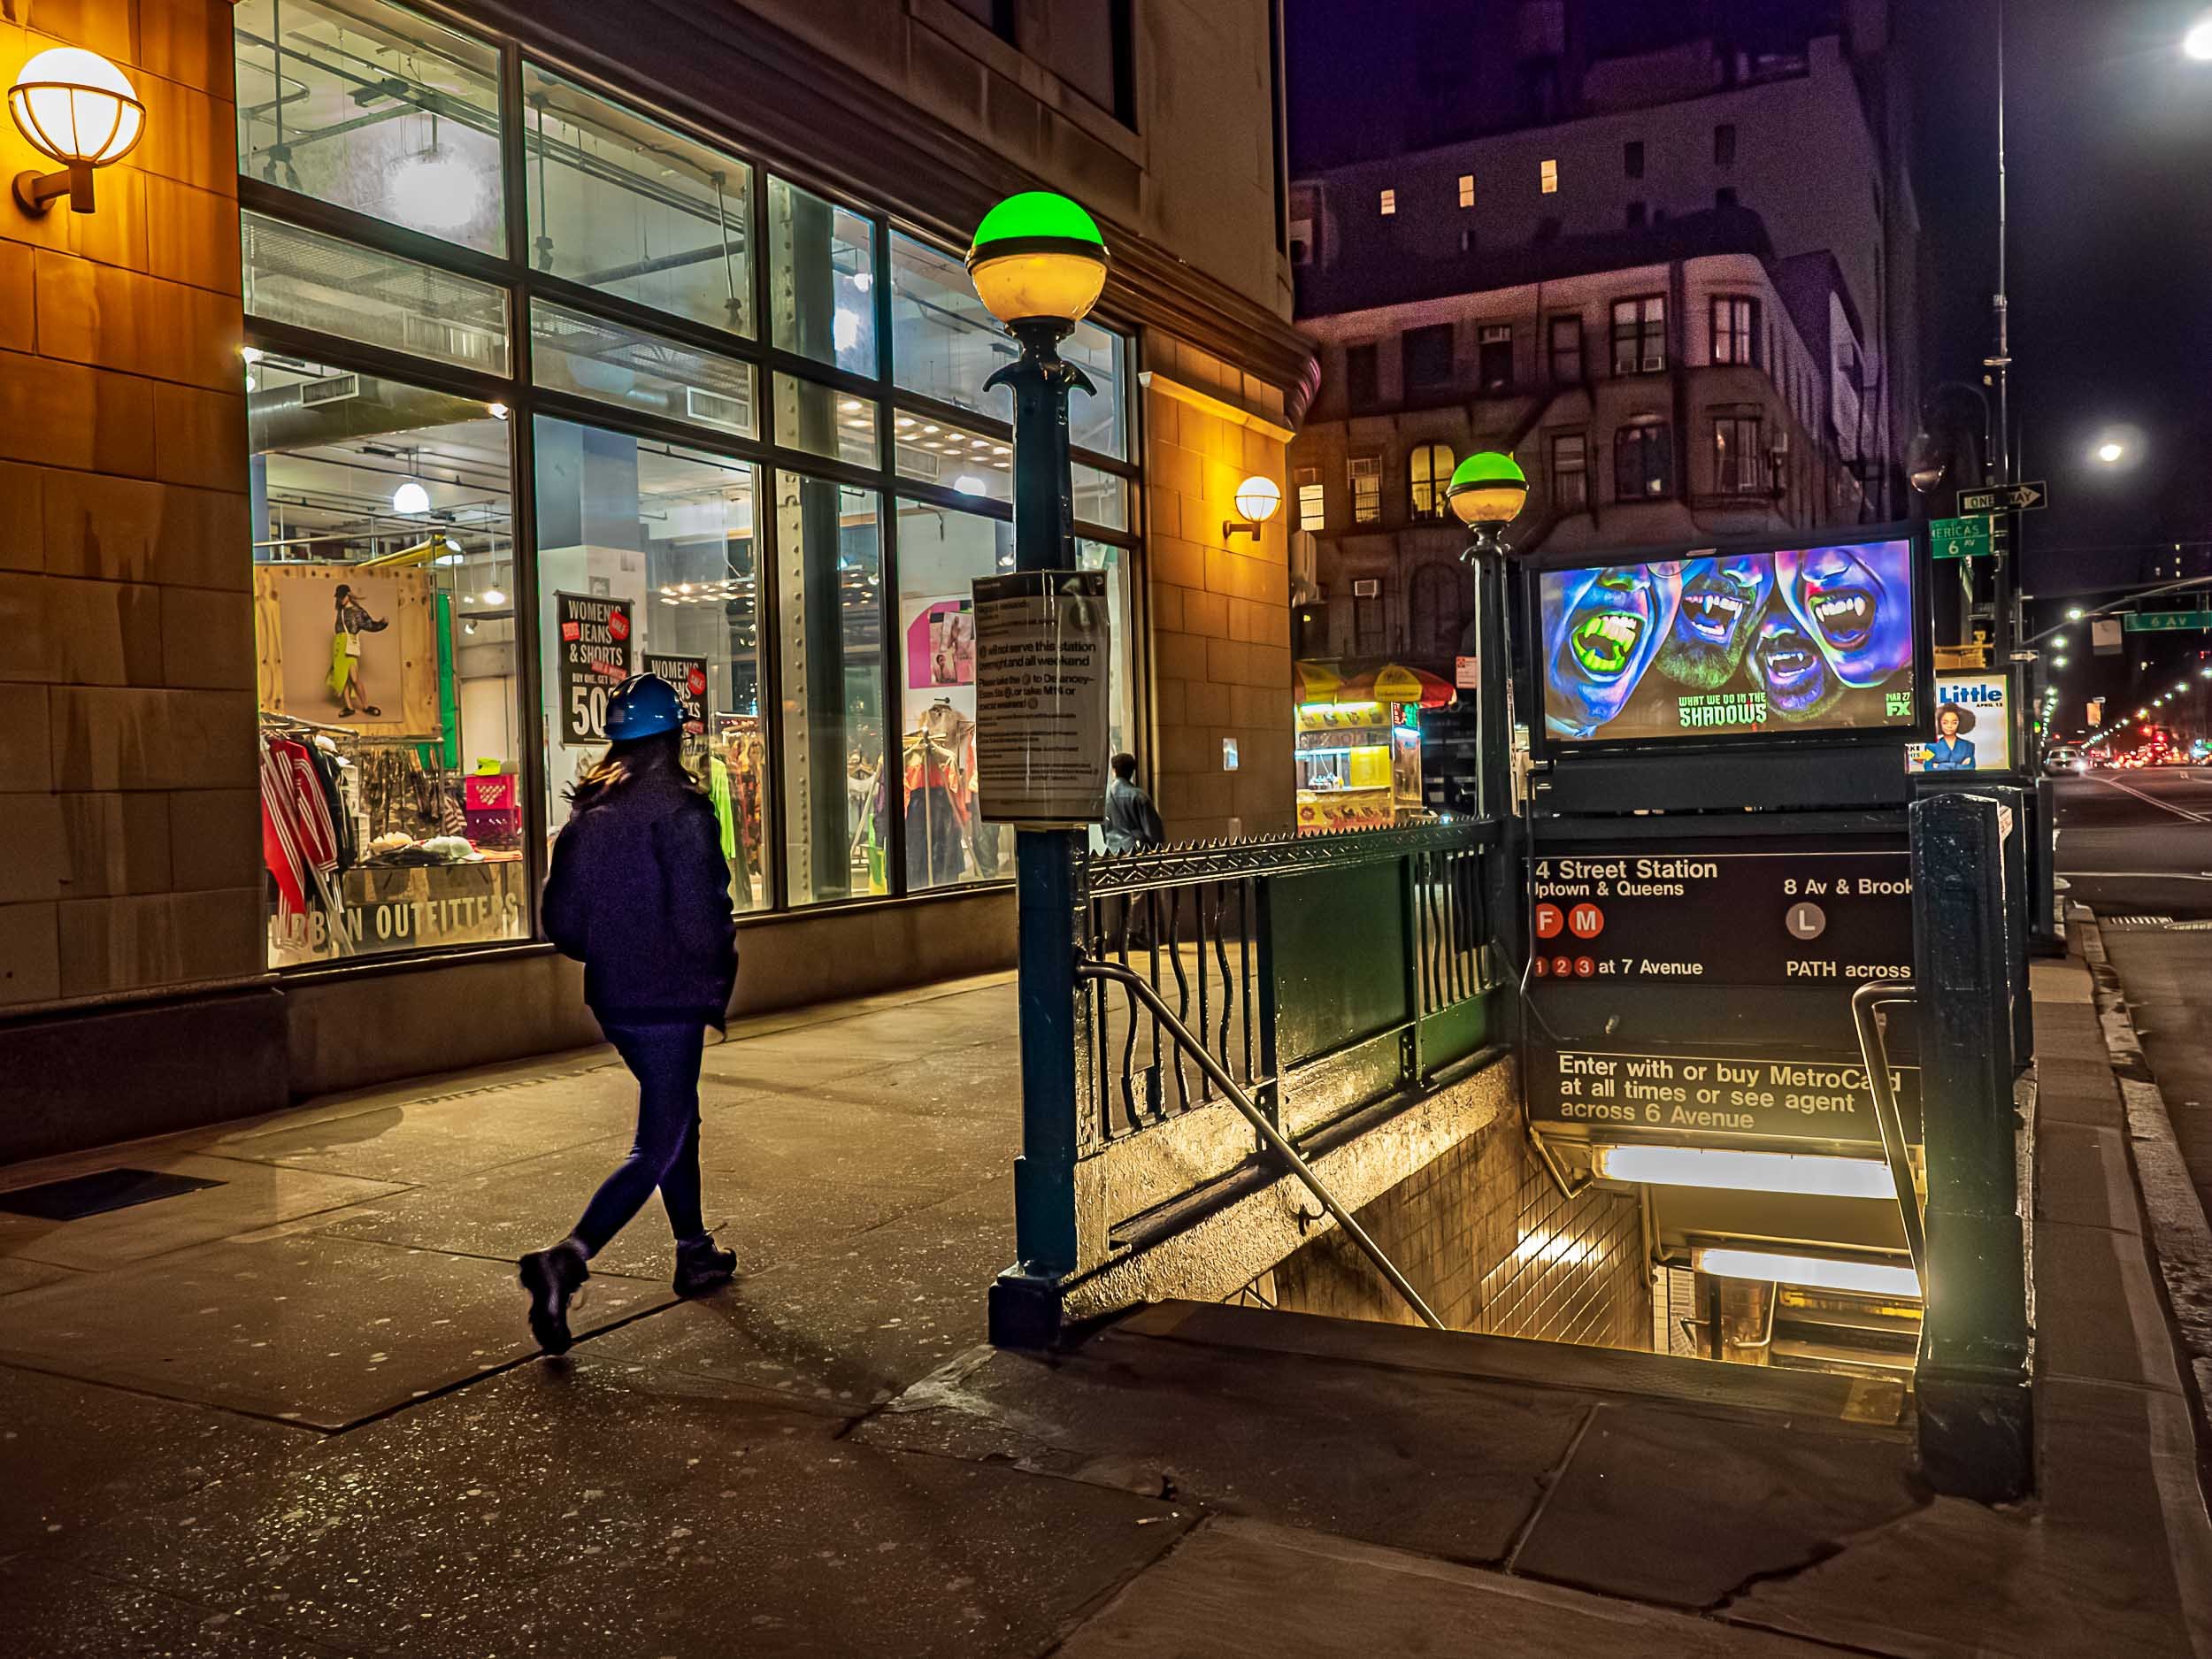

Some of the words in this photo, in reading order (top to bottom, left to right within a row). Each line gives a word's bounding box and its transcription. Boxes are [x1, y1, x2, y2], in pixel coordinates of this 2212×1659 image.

[1948, 540, 1960, 555] 6
[568, 600, 622, 622] WOMEN'
[580, 622, 612, 644] JEANS
[569, 643, 579, 664] &
[580, 644, 623, 666] SHORTS
[1035, 639, 1056, 652] this
[1059, 640, 1096, 652] station
[651, 659, 699, 680] WOMEN'
[1678, 695, 1704, 706] WHAT
[1707, 695, 1721, 704] WE
[1723, 694, 1735, 704] DO
[1737, 693, 1747, 703] IN
[1748, 692, 1766, 703] THE
[1939, 684, 2002, 703] Little
[572, 686, 612, 739] 50
[1678, 703, 1767, 727] SHADOWS
[1886, 702, 1911, 717] FX
[1535, 861, 1551, 879] 4
[1560, 860, 1627, 879] Street
[1637, 859, 1717, 879] Station
[1597, 881, 1609, 896] &
[1617, 880, 1685, 896] Queens
[1784, 879, 1797, 895] 8
[1805, 879, 1827, 895] Av
[1836, 879, 1850, 895] &
[376, 892, 518, 941] OUTFITTERS
[1540, 910, 1554, 931] F
[1576, 910, 1596, 931] M
[1799, 910, 1816, 931] L
[1536, 961, 1543, 974] 1
[1556, 961, 1567, 974] 2
[1578, 961, 1589, 974] 3
[1599, 960, 1616, 974] at
[1622, 959, 1632, 974] 7
[1640, 959, 1703, 975] Avenue
[1786, 961, 1836, 977] PATH
[1845, 965, 1911, 978] across
[1559, 1055, 1617, 1076] Enter
[1626, 1059, 1673, 1079] with
[1683, 1065, 1707, 1080] or
[1717, 1063, 1760, 1087] buy
[1770, 1065, 1901, 1092] MetroCad
[1561, 1078, 1582, 1095] at
[1591, 1079, 1615, 1097] all
[1624, 1080, 1686, 1102] times
[1696, 1088, 1720, 1104] or
[1731, 1090, 1774, 1107] see
[1785, 1094, 1855, 1114] agent
[1561, 1102, 1636, 1121] across
[1645, 1102, 1661, 1123] 6
[1671, 1104, 1755, 1129] Avenue
